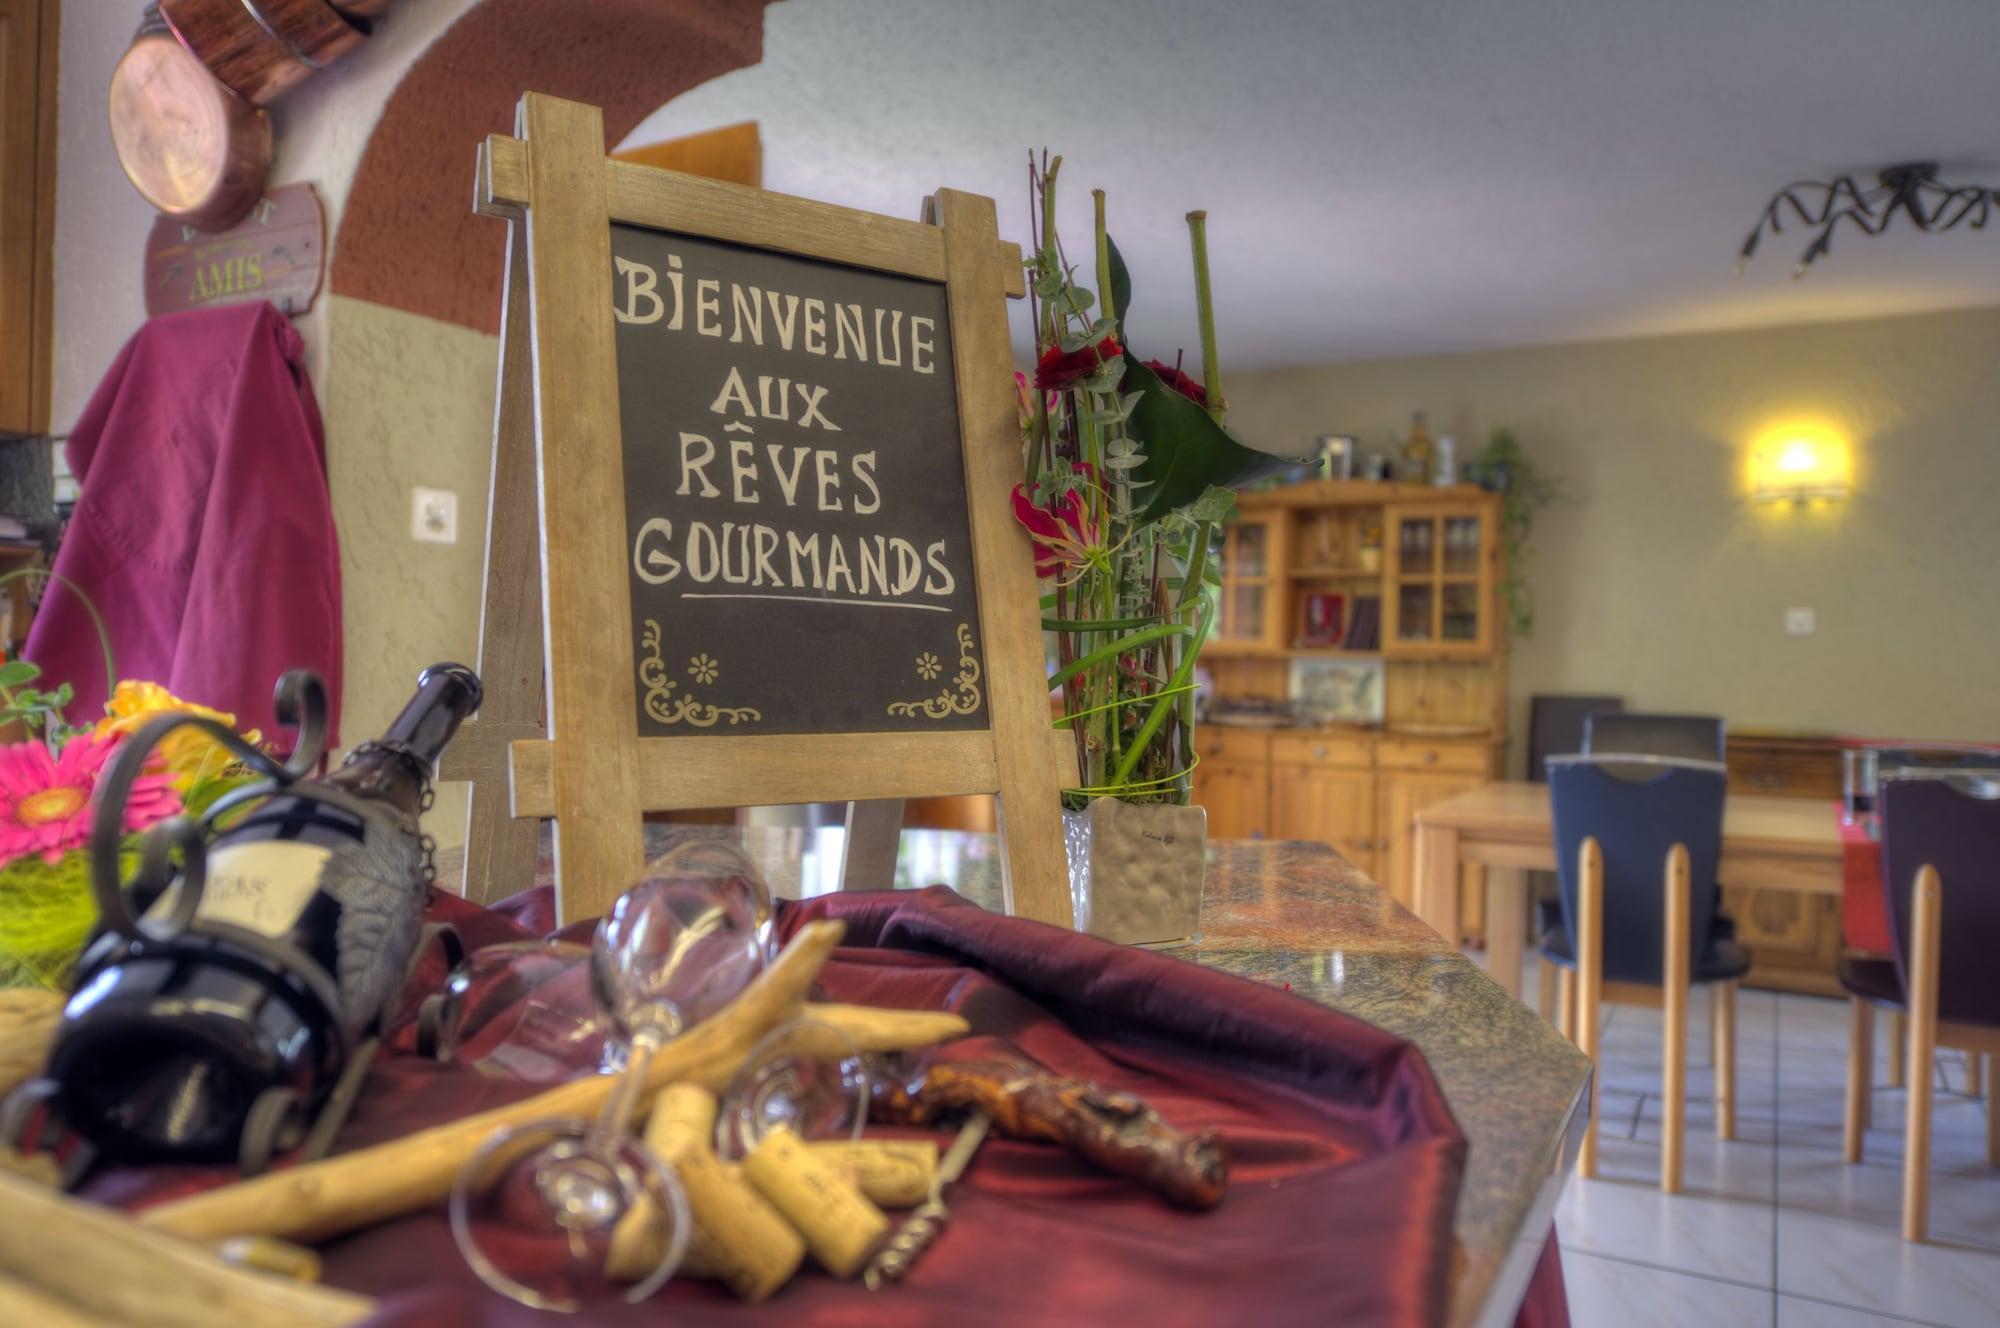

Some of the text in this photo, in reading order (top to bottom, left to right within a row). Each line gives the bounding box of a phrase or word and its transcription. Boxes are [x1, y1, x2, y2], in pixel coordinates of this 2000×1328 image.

[188, 255, 265, 302] AMIS
[710, 366, 842, 431] AUX
[675, 421, 881, 515] RÊVES
[633, 517, 956, 596] GOURMANDS
